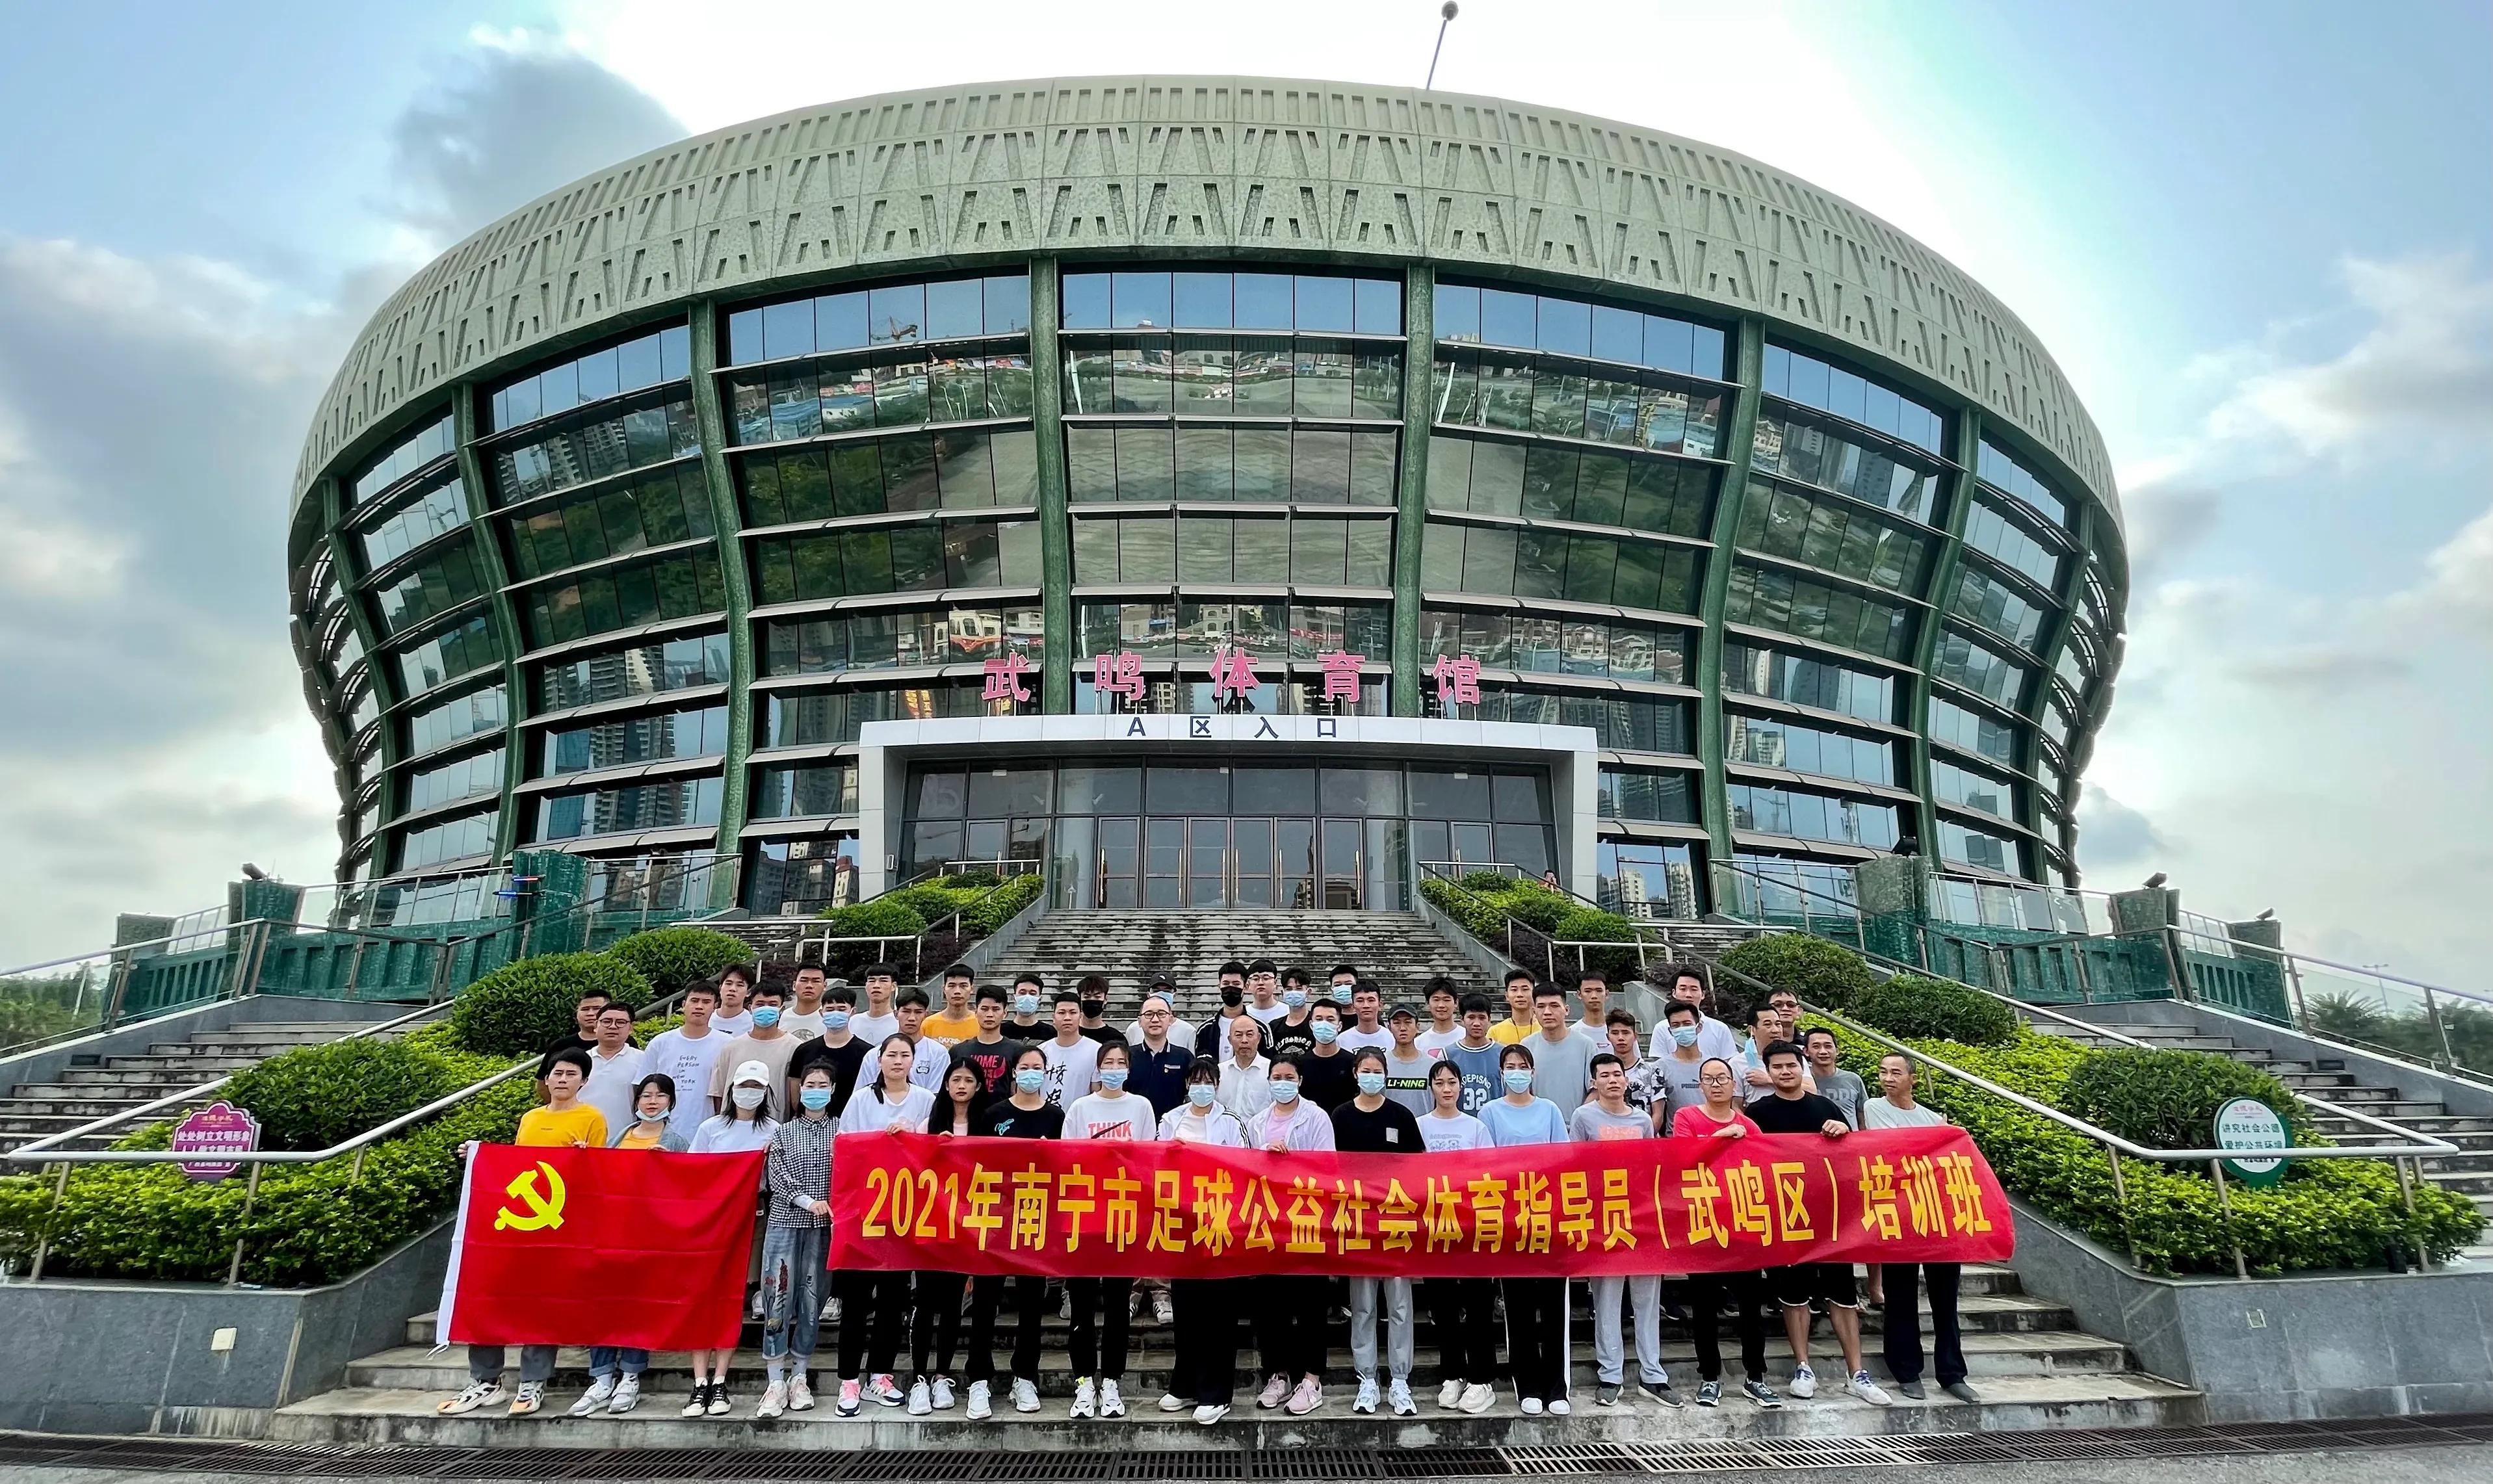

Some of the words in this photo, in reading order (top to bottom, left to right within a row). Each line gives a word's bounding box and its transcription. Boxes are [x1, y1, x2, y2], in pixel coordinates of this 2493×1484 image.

[982, 650, 1480, 704] 武鸣体育馆
[1127, 716, 1336, 738] A区入口
[1387, 1079, 1426, 1088] LI-NING
[1463, 1088, 1488, 1110] 32
[1088, 1121, 1132, 1138] THINK
